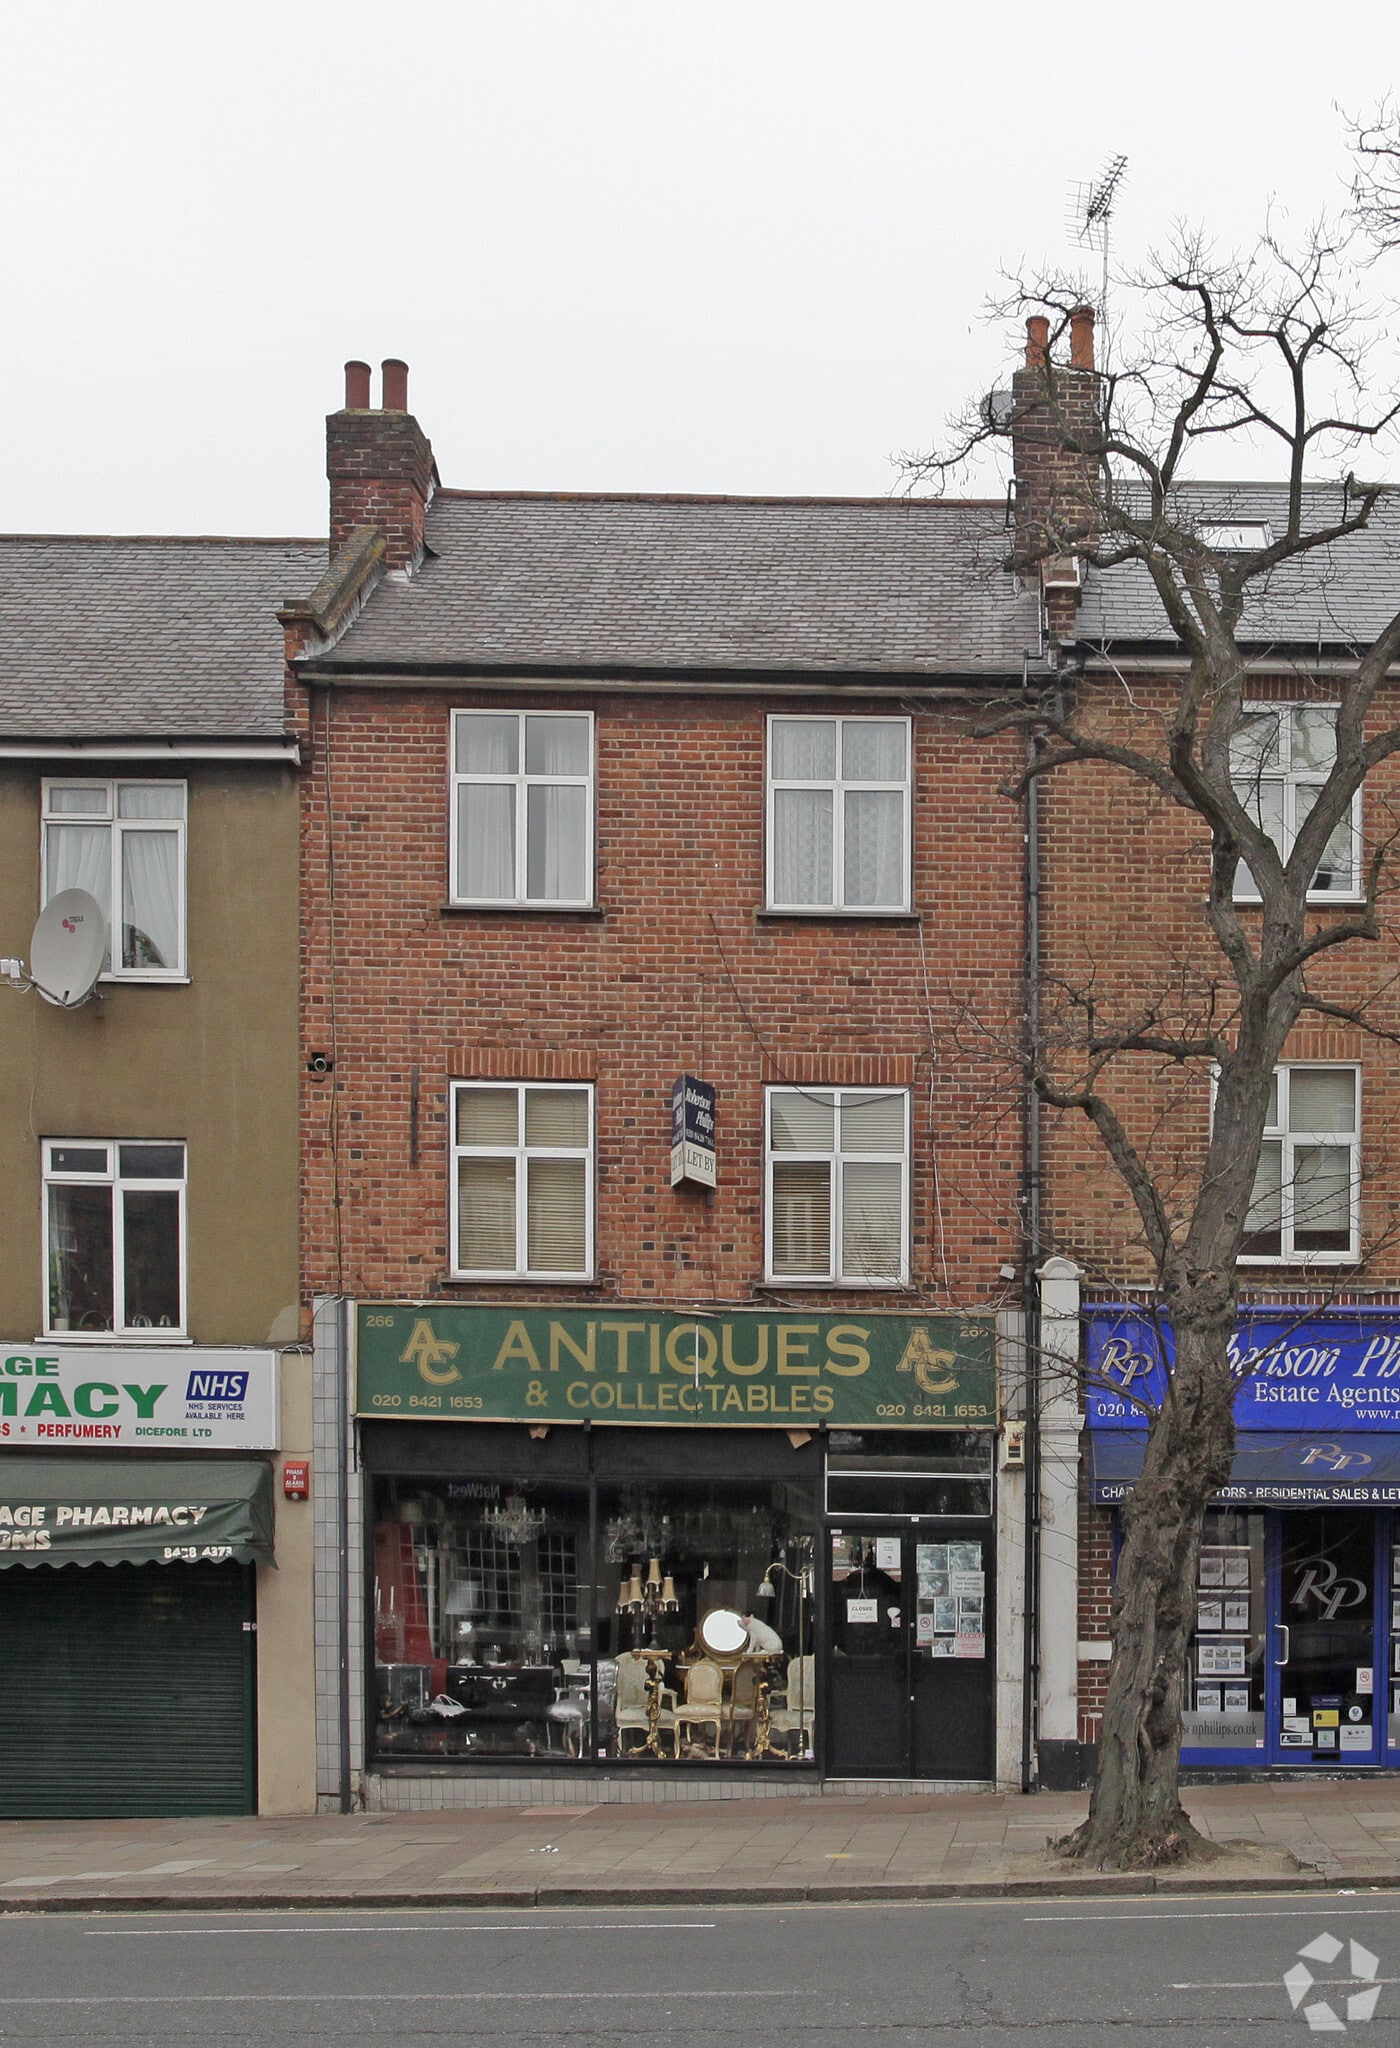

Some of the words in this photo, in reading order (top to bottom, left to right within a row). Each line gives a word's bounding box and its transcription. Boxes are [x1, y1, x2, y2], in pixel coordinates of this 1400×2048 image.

[687, 1149, 703, 1168] LET
[704, 1155, 715, 1173] BY
[366, 1315, 394, 1327] 266
[490, 1319, 871, 1379] ANTIQUES
[0, 1356, 60, 1376] GE
[191, 1375, 243, 1397] NHS
[372, 1394, 401, 1407] 020
[409, 1395, 442, 1408] 8421
[450, 1396, 483, 1409] 1653
[525, 1380, 548, 1407] &
[566, 1382, 834, 1413] COLLECTABLES
[1255, 1382, 1320, 1402] Estate
[1327, 1383, 1400, 1408] Agents
[208, 1403, 243, 1411] SERVICES
[876, 1404, 906, 1416] 020
[913, 1404, 946, 1417] 8421
[954, 1405, 987, 1417] 1653
[1097, 1403, 1125, 1417] 020
[185, 1412, 222, 1420] AVAILABLE
[37, 1423, 122, 1438] PERFUMERY
[135, 1427, 188, 1437] DICEFORE
[193, 1428, 212, 1437] LTD
[1256, 1487, 1330, 1500] RESIDENTIAL
[1332, 1488, 1369, 1500] SALES
[1372, 1488, 1380, 1500] &
[56, 1506, 208, 1526] PHARMACY
